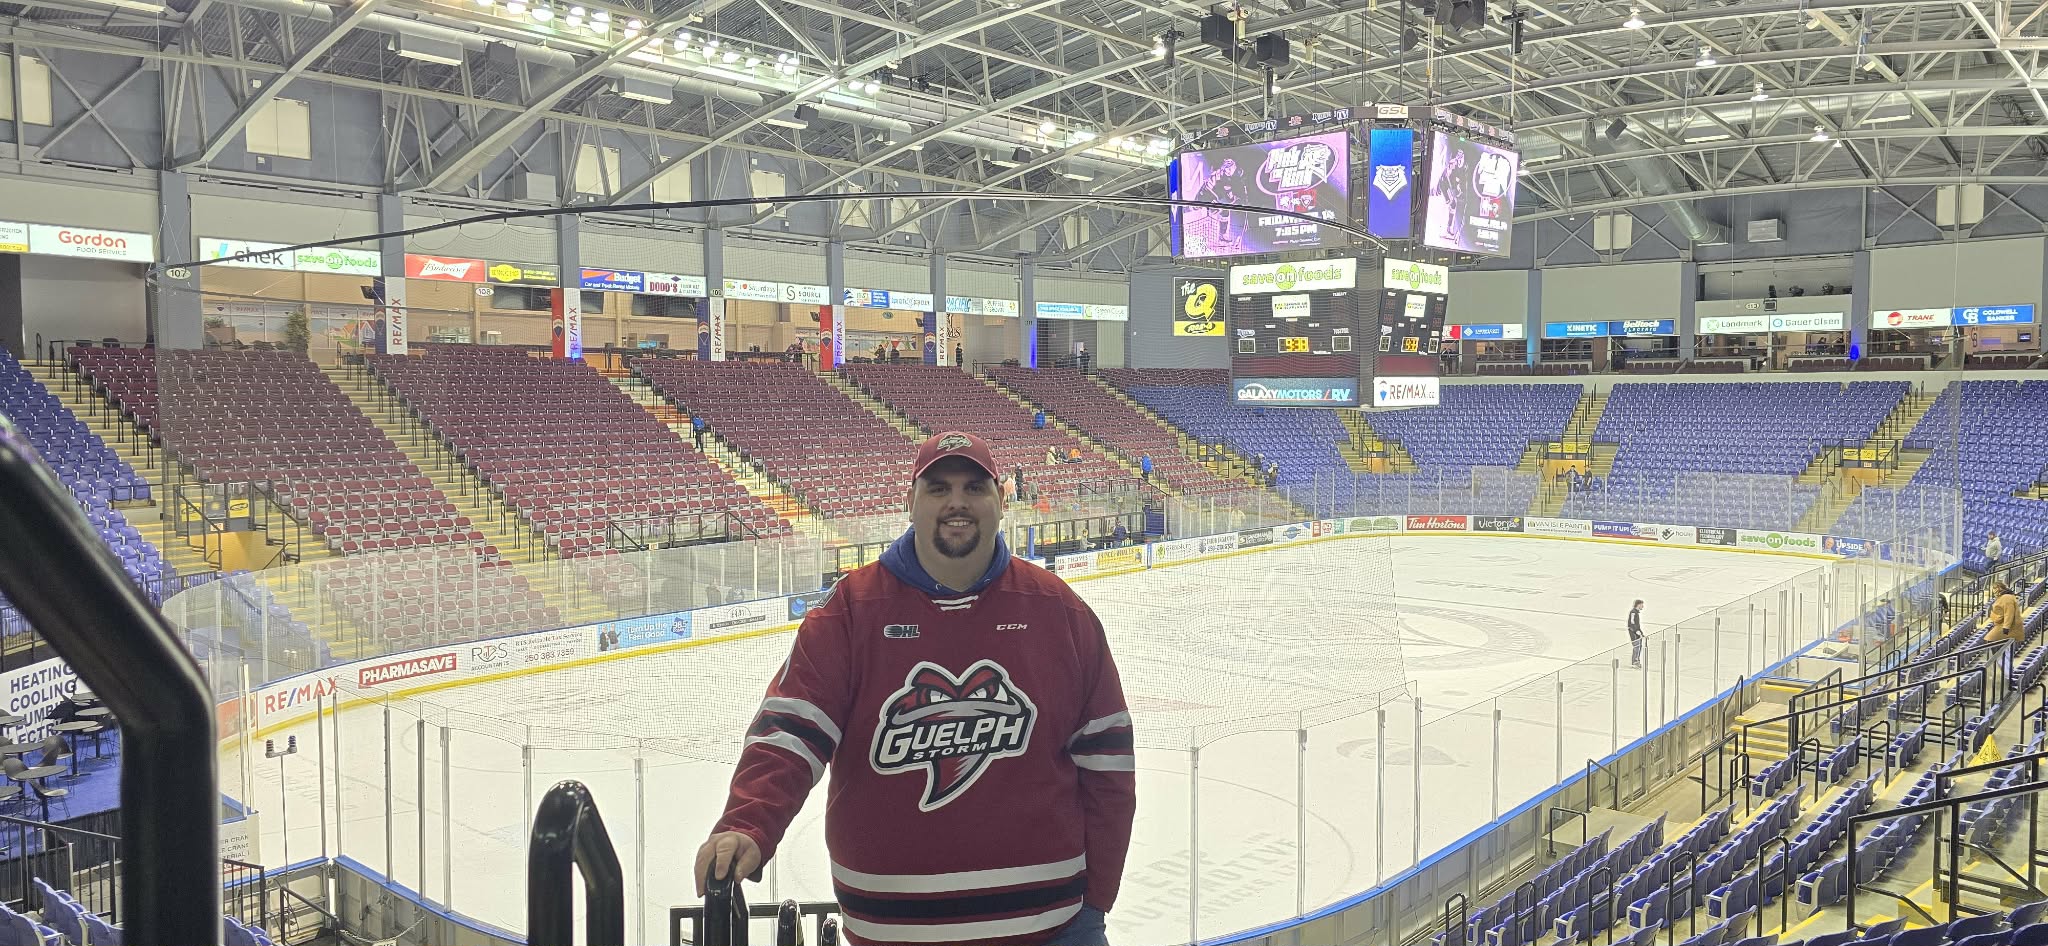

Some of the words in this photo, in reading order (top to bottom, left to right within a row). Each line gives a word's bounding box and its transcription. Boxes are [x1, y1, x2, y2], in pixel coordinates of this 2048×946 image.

[1379, 106, 1407, 115] GSL
[58, 230, 126, 249] Gordon
[76, 246, 97, 254] FOOD
[98, 248, 127, 256] SERVICE
[169, 269, 187, 278] 107
[424, 262, 467, 275] Budweiser
[1242, 272, 1275, 286] save
[1276, 271, 1297, 283] on
[1298, 264, 1342, 282] foods
[613, 272, 642, 284] Budget
[649, 281, 678, 293] DODD'S
[1184, 283, 1218, 322] Q
[1982, 308, 2019, 316] COLDWELL
[392, 298, 402, 346] RE/MAX
[568, 307, 577, 350] RE/MAX
[1566, 324, 1597, 333] KINETIC
[1721, 319, 1763, 329] Landmark
[1331, 388, 1350, 401] RV
[1407, 517, 1426, 529] Tim
[1426, 517, 1465, 530] Hortons
[1565, 522, 1584, 530] PAINT
[1740, 534, 1766, 544] save
[1767, 536, 1782, 545] on
[1783, 536, 1816, 548] foods
[996, 623, 1028, 631] CCM
[362, 656, 454, 685] PHARMASAVE
[10, 679, 77, 713] COOLING
[265, 675, 339, 715] RE/MAX
[878, 715, 1026, 765] GUELPH
[912, 741, 987, 761] STORM
